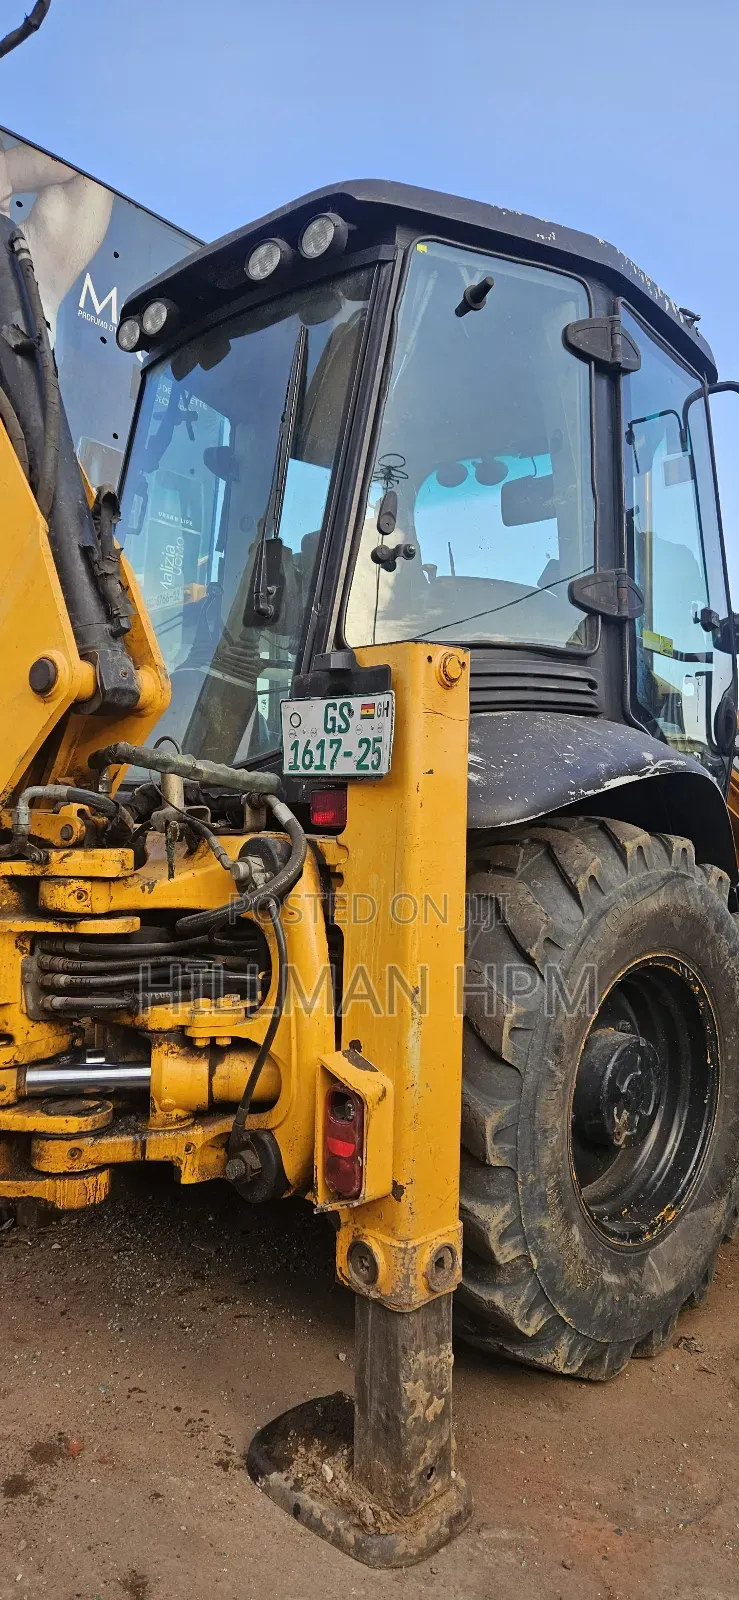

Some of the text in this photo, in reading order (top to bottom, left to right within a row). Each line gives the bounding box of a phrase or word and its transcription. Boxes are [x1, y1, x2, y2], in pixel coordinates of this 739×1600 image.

[79, 272, 121, 324] M
[158, 511, 193, 527] URBAN LIFE
[173, 536, 185, 576] UOMO
[323, 702, 351, 734] GS
[376, 700, 390, 718] GH
[288, 736, 383, 771] 1617-25
